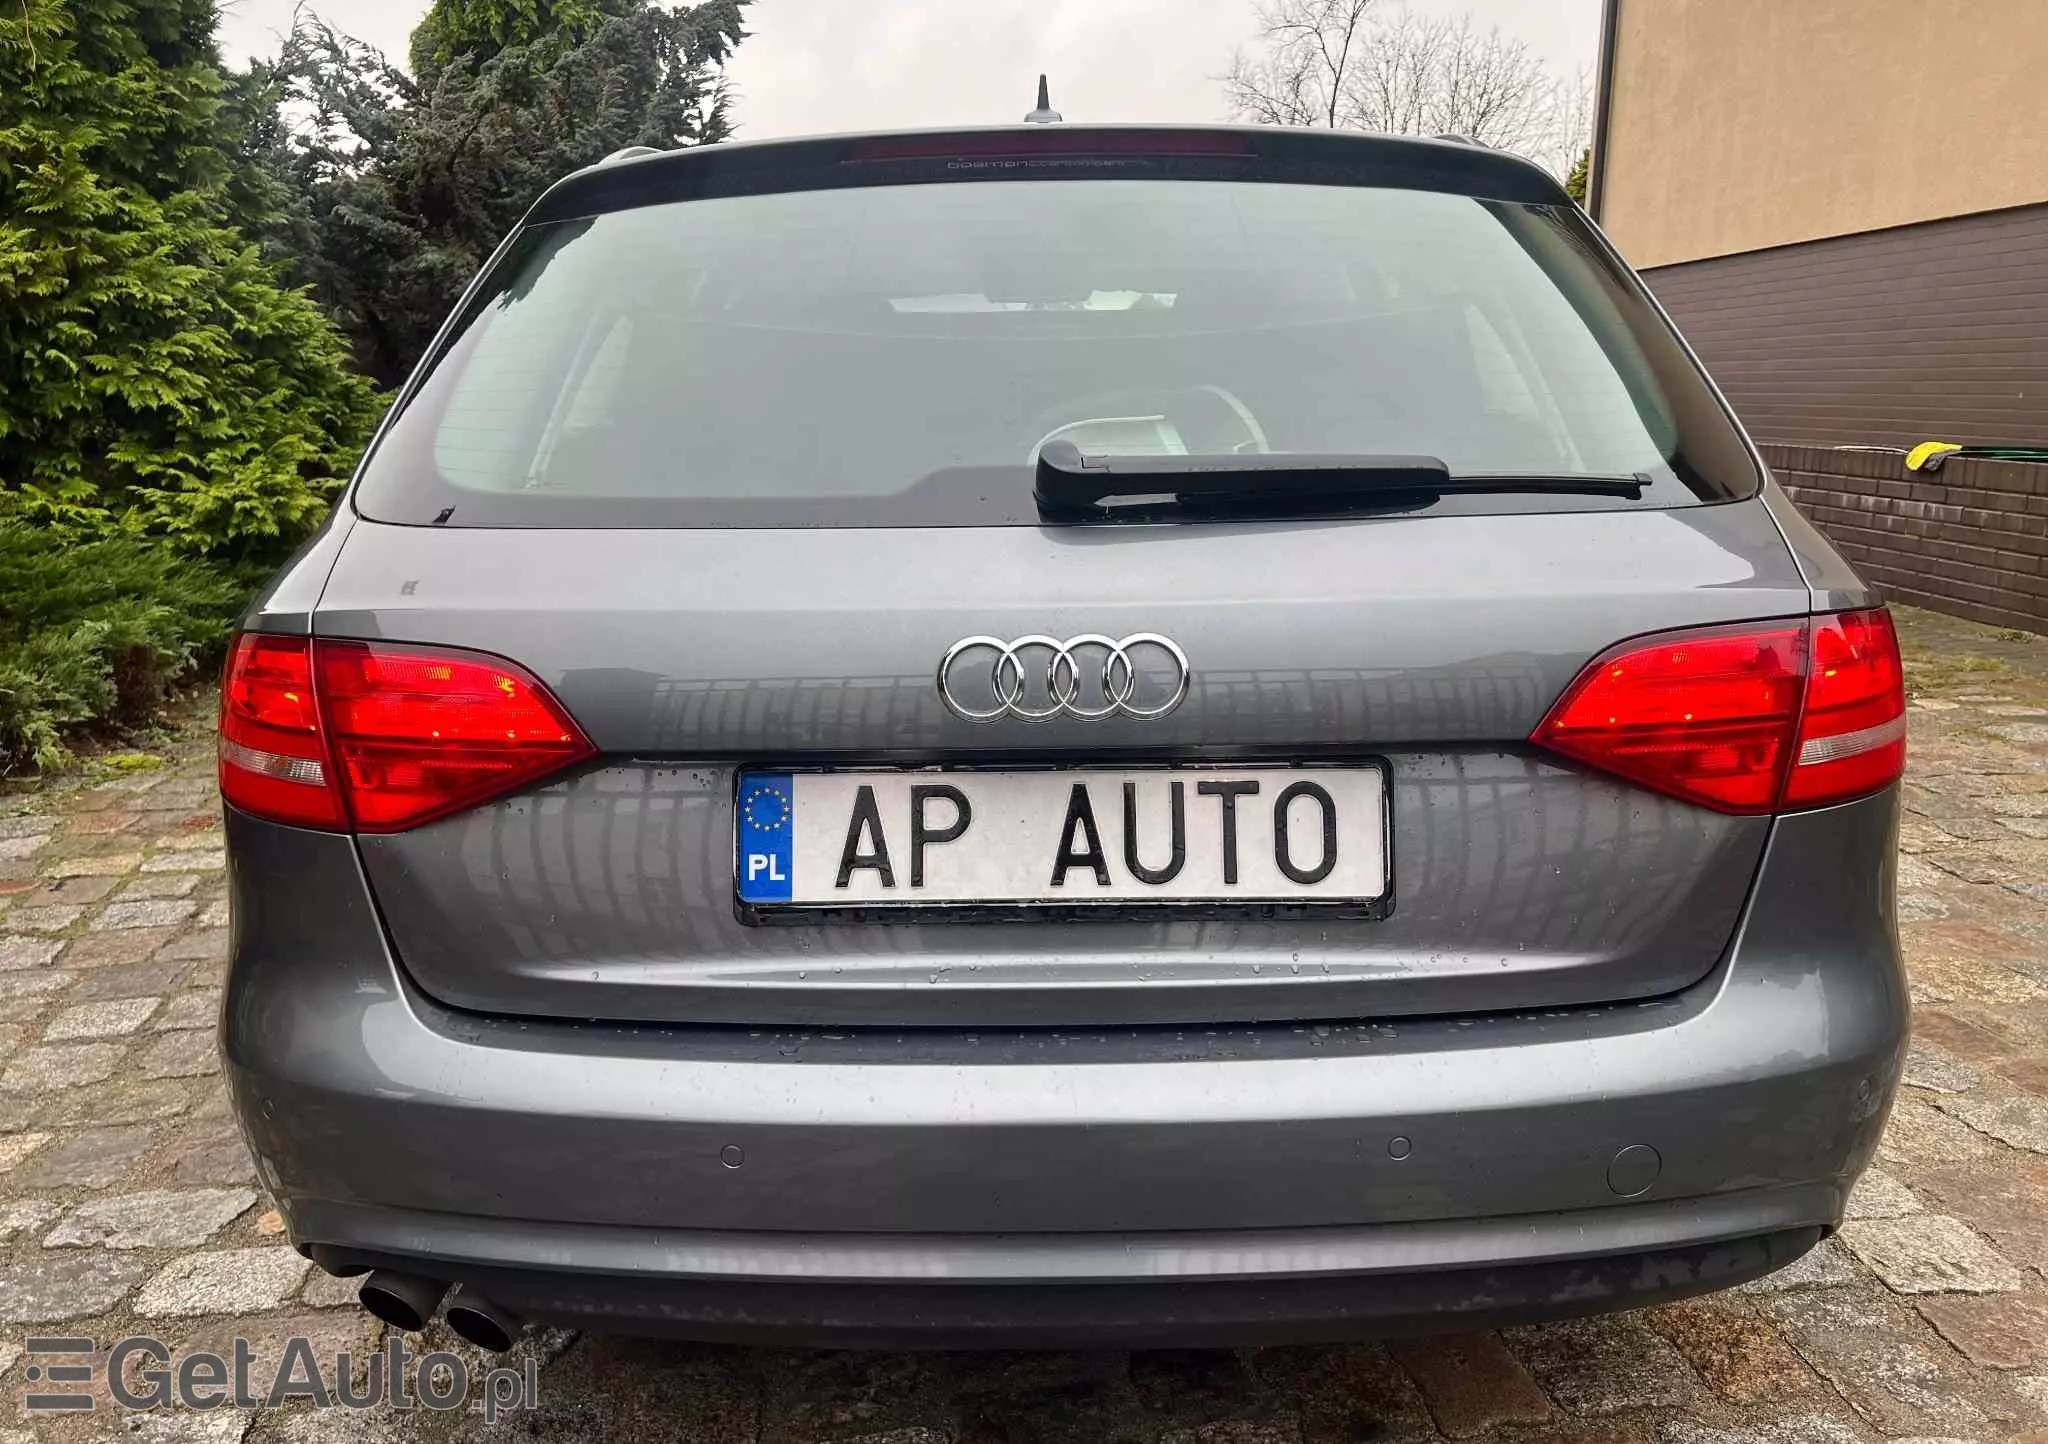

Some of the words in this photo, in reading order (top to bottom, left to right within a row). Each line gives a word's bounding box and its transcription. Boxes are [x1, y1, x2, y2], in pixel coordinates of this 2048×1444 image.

[748, 854, 786, 881] PL
[835, 783, 972, 888] AP
[1050, 780, 1337, 887] AUTO
